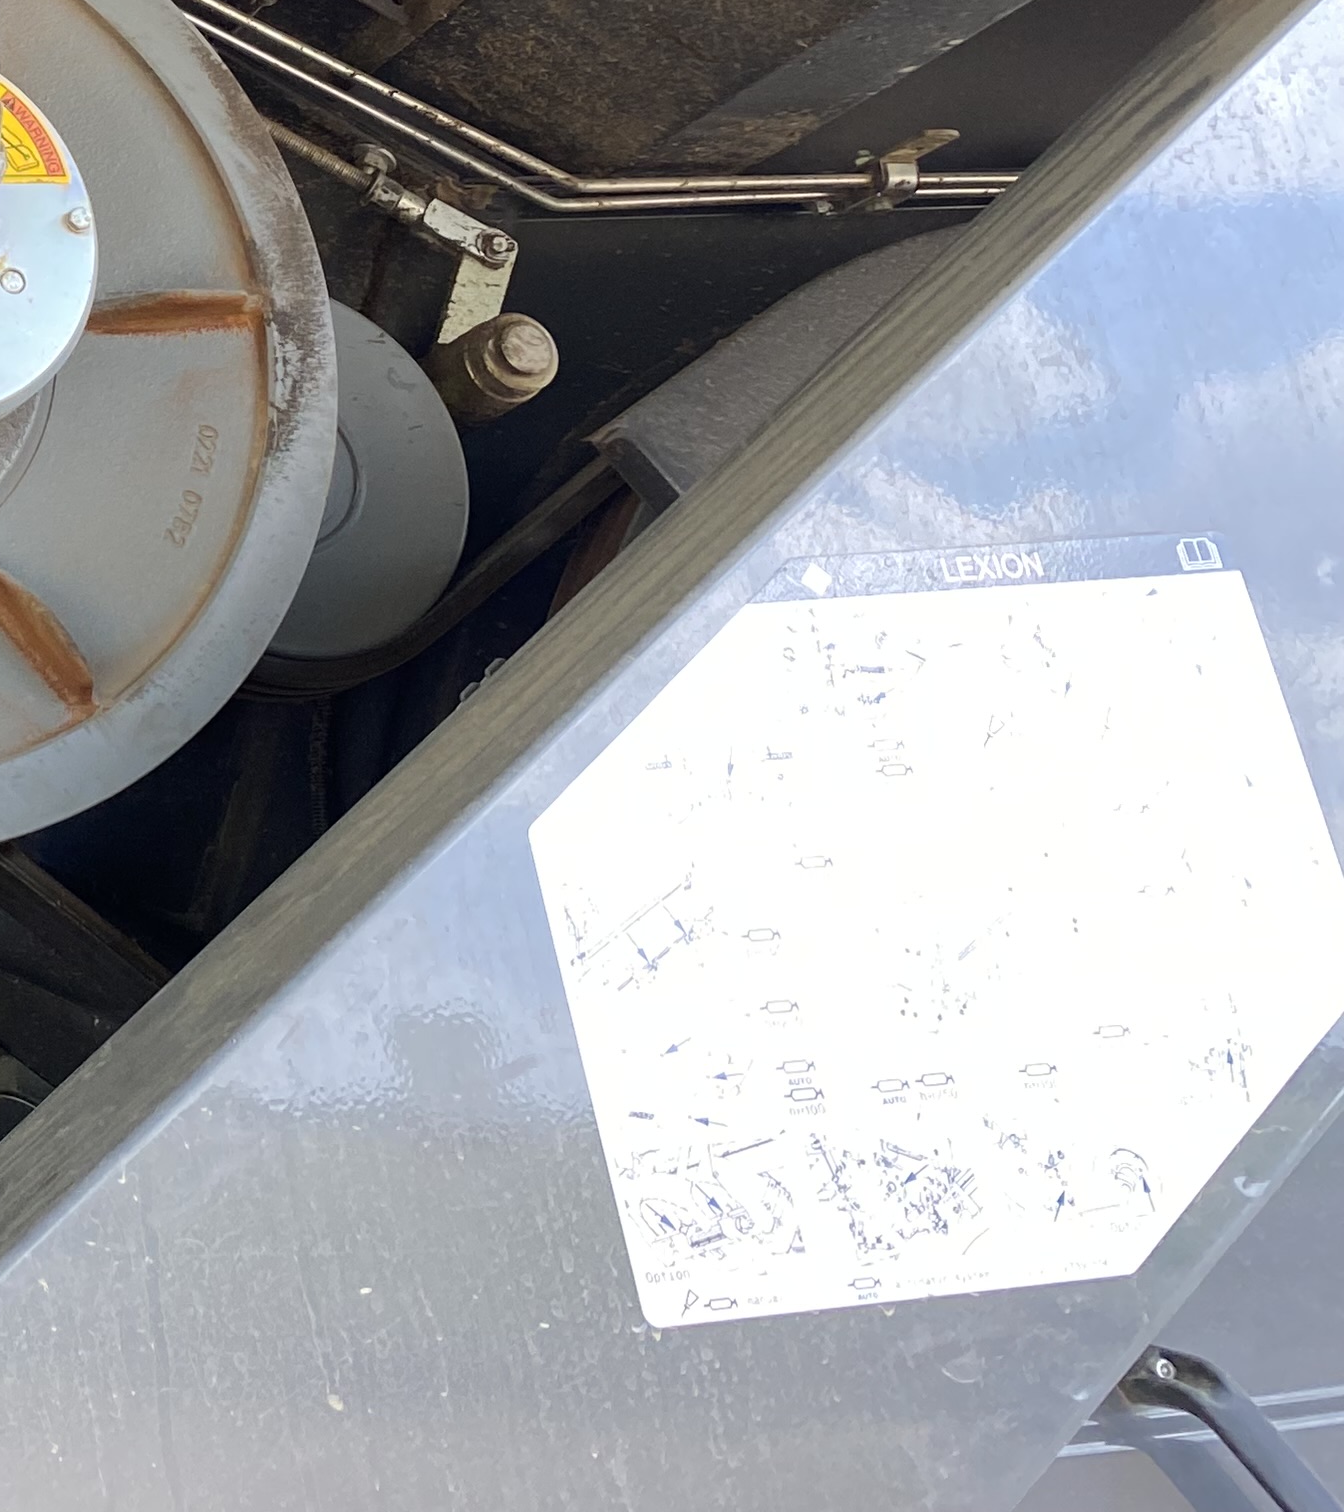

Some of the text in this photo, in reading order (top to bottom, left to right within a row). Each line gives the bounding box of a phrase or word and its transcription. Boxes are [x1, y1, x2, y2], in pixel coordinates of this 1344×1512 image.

[14, 101, 60, 175] WARNING
[940, 551, 1045, 583] LEXION
[788, 1076, 812, 1086] AUTO
